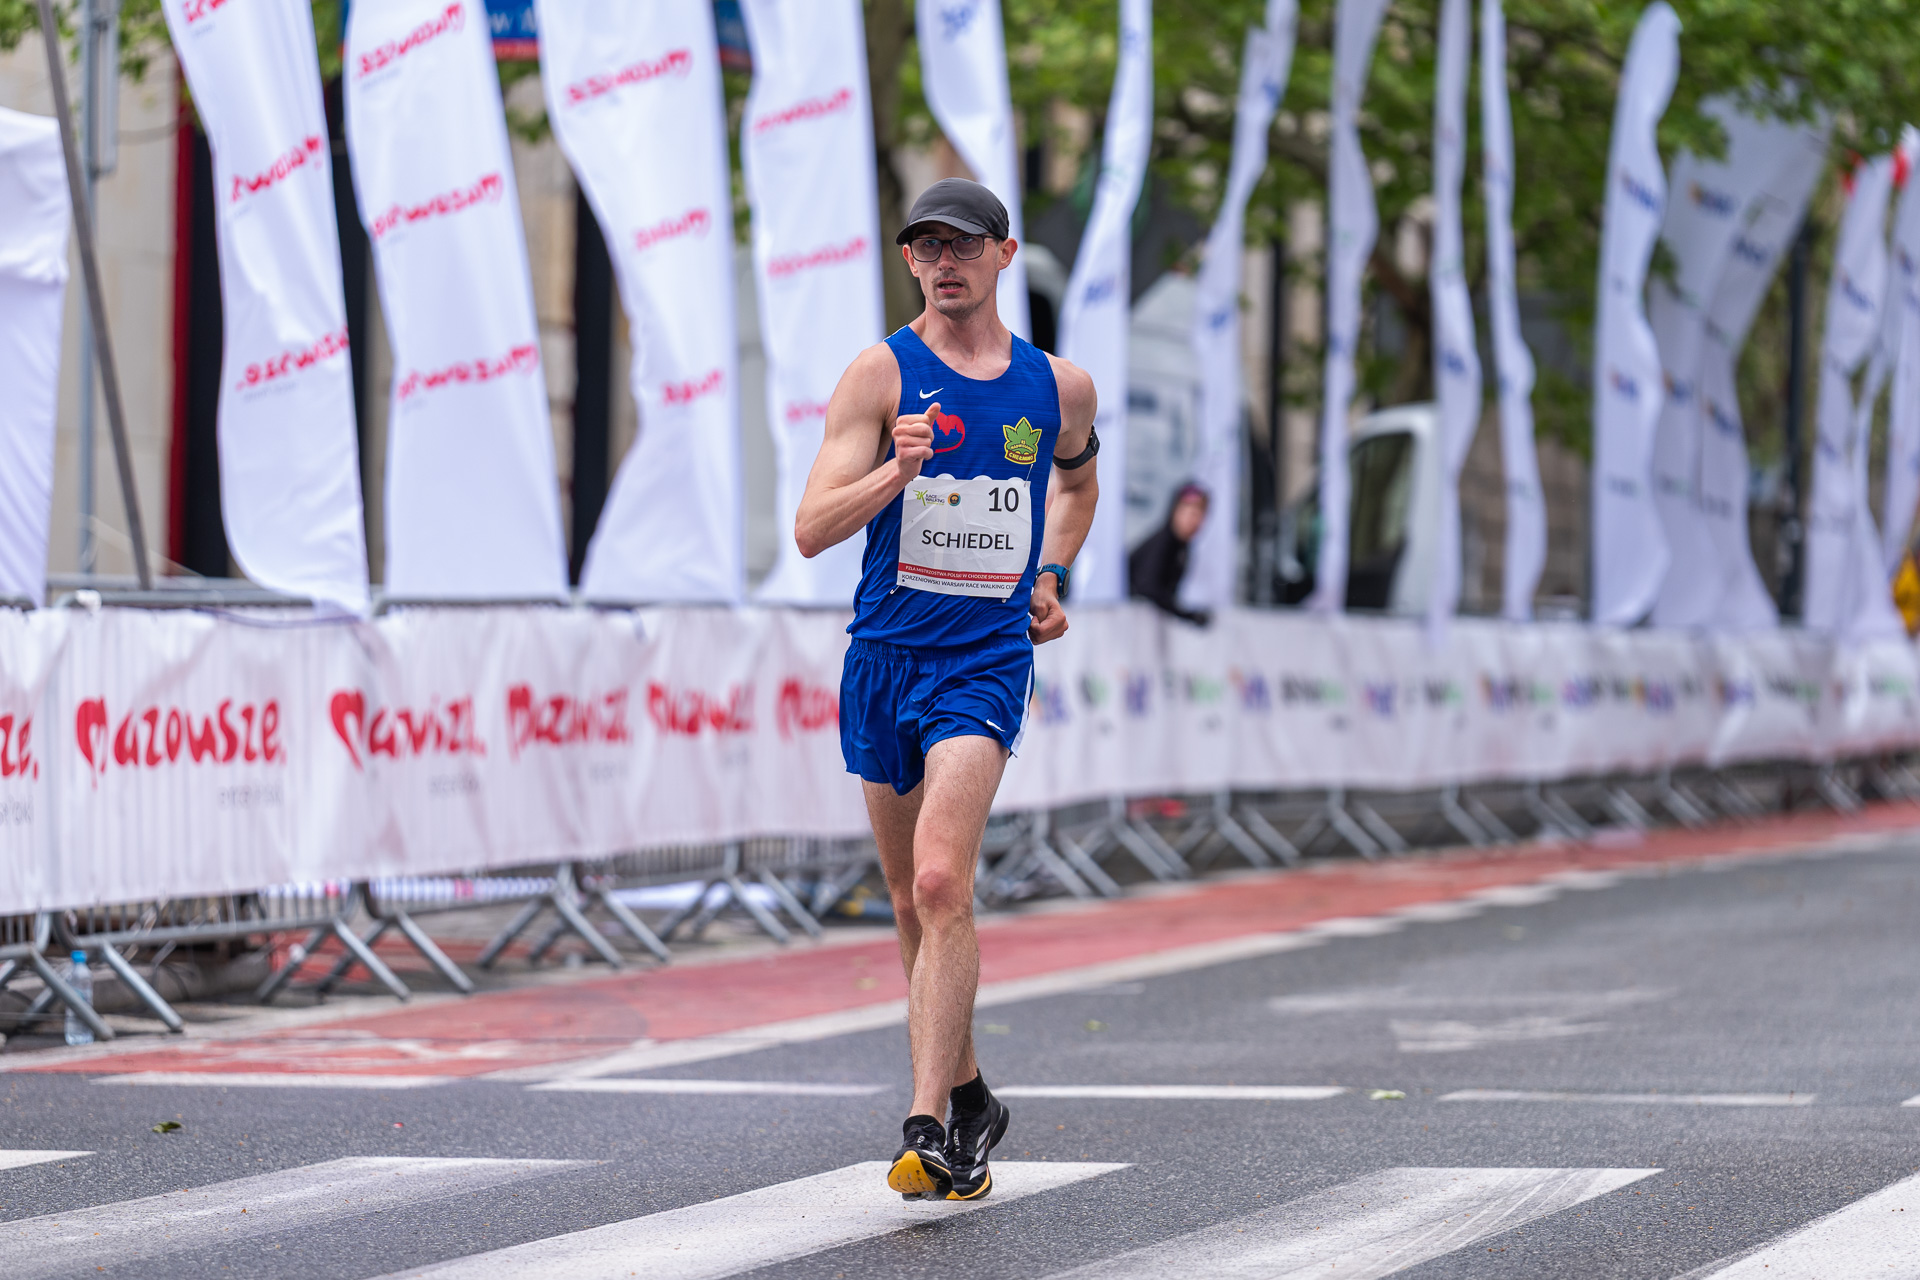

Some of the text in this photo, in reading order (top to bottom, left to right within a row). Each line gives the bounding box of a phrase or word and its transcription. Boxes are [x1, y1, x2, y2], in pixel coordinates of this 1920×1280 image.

[988, 487, 1019, 512] 10
[921, 529, 1014, 550] SCHIEDEL
[902, 574, 940, 585] KORZENIOWSKI
[917, 567, 947, 577] MISTRZOSTWA
